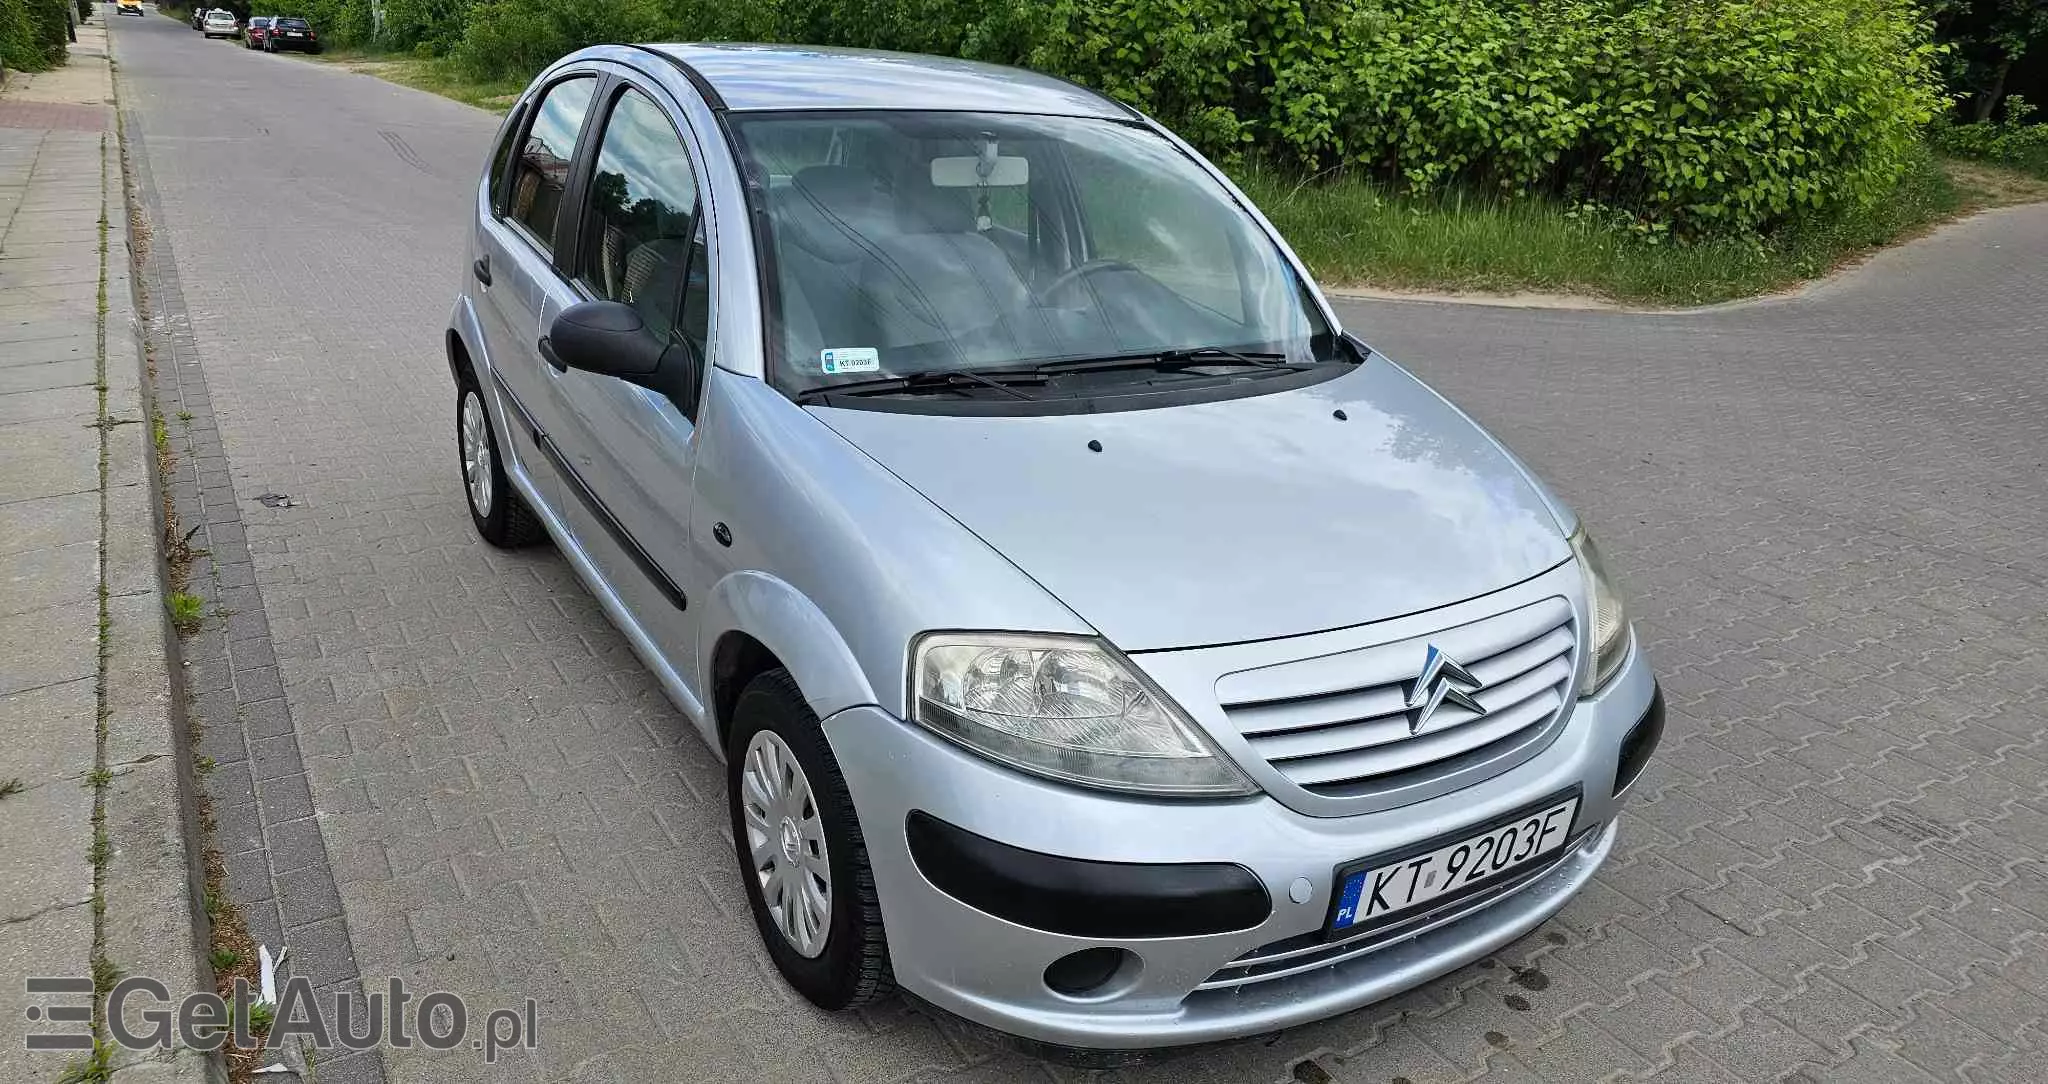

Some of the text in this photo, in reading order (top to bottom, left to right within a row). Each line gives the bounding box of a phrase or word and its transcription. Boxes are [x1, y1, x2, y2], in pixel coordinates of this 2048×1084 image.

[1366, 807, 1566, 916] KT 9203F
[1336, 908, 1353, 921] PL
